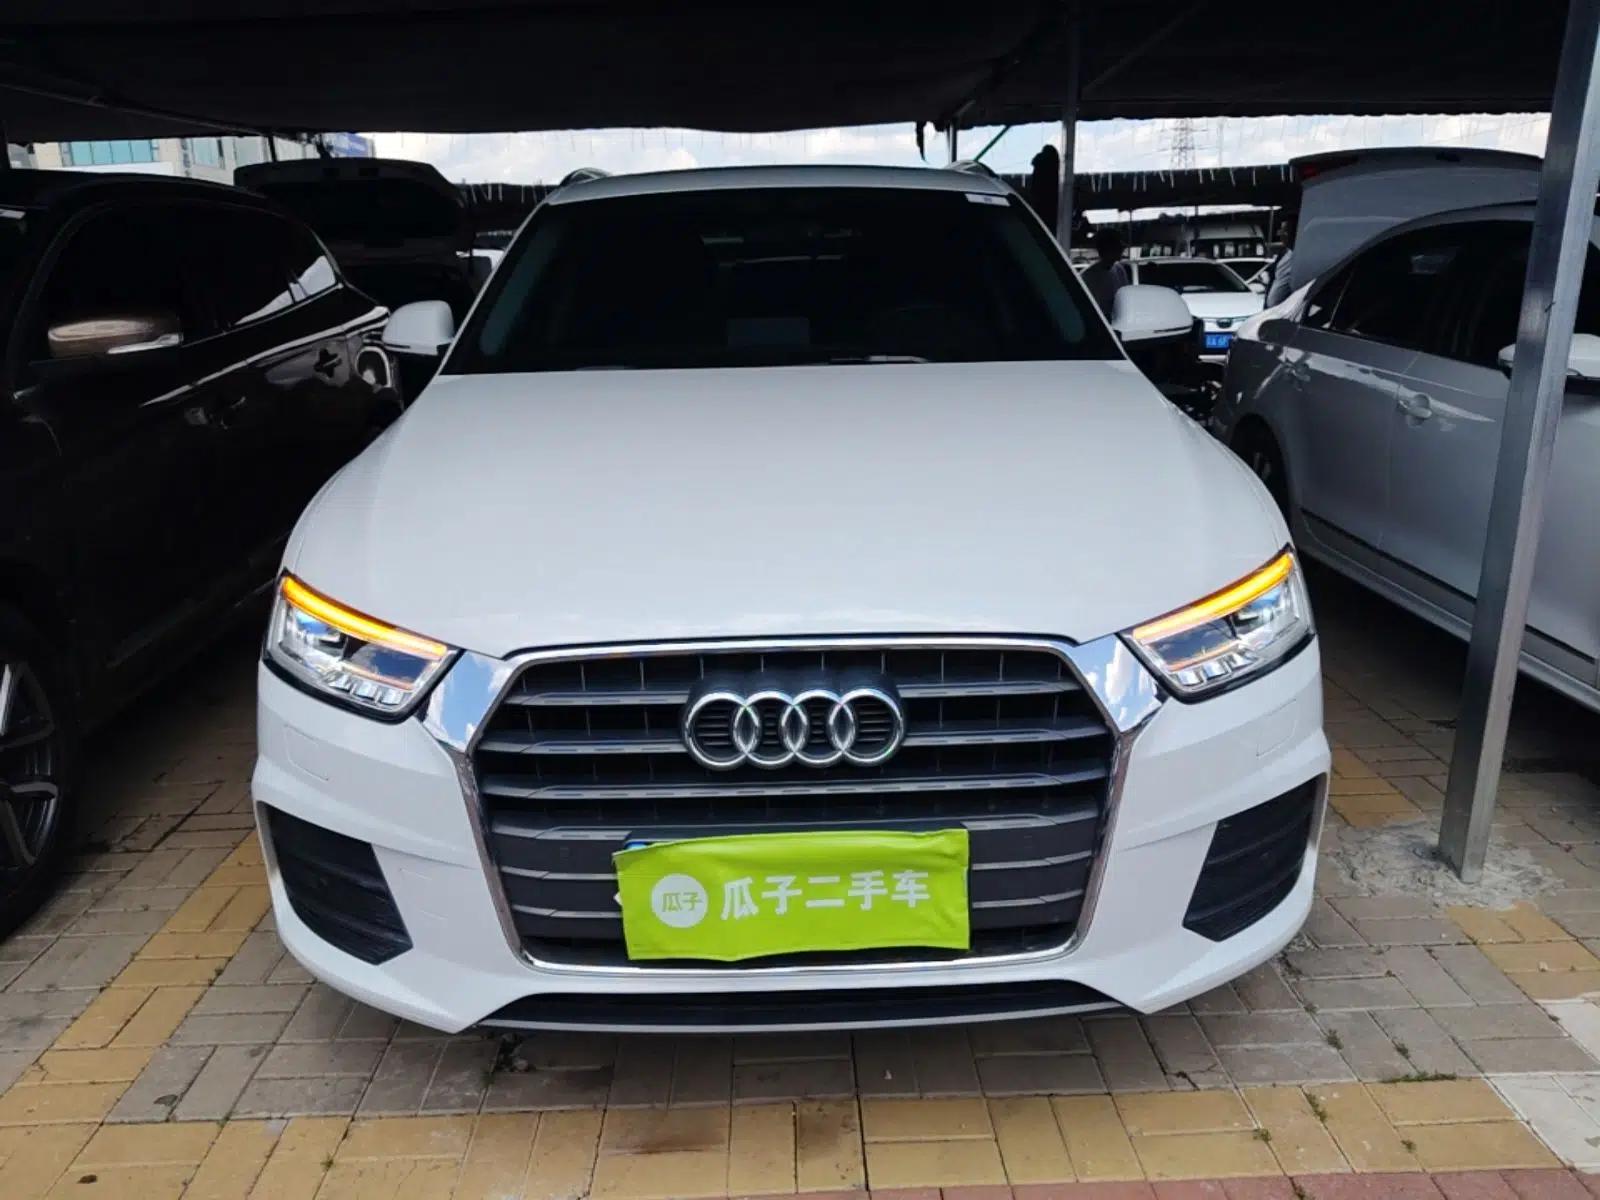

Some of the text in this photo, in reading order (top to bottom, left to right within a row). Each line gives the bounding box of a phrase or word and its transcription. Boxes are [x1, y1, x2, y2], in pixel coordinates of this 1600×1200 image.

[661, 891, 704, 913] 瓜子
[720, 870, 930, 920] 瓜子二手车
